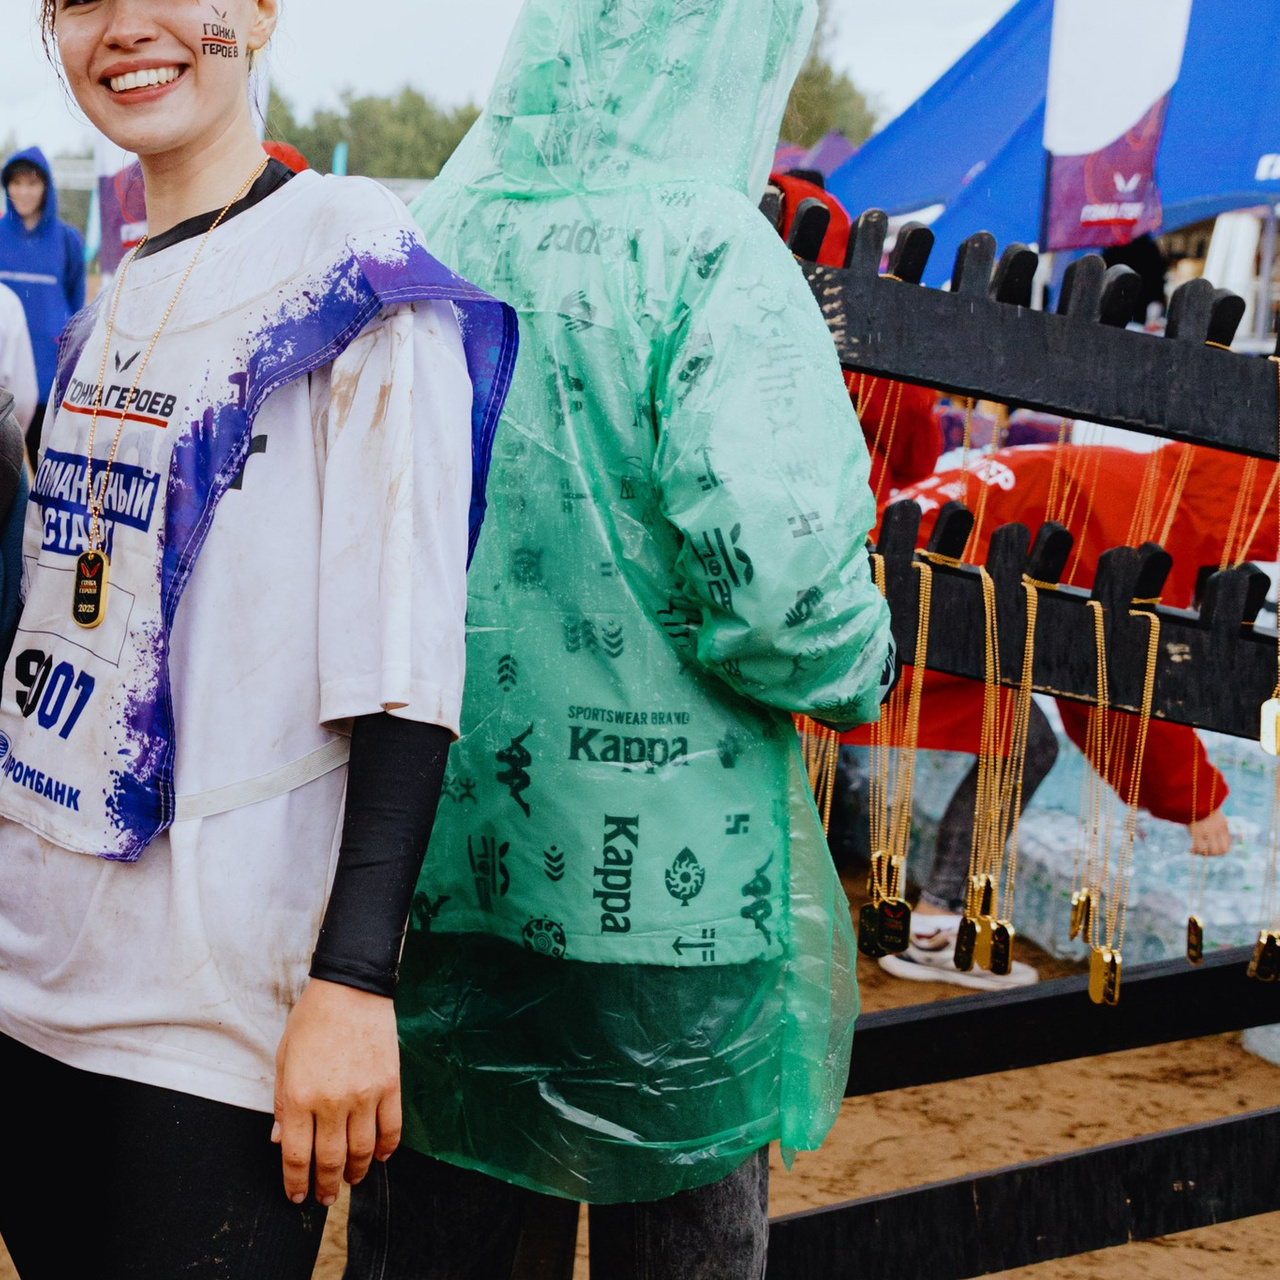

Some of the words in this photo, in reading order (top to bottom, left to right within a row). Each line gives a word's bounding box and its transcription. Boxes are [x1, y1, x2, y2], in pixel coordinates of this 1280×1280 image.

[201, 43, 239, 58] ГЕРОЕВ
[202, 23, 236, 40] ГОНКА
[65, 378, 105, 407] ГОНКА
[104, 385, 177, 417] ГЕРОЕВ
[33, 458, 155, 521] ОМАНДНЫЙ
[43, 507, 114, 556] СТАРТ
[77, 604, 95, 613] 2025
[568, 705, 648, 725] SPORTSWEAR
[651, 711, 690, 725] BRAND
[567, 725, 690, 774] Kappa
[593, 813, 639, 934] Kappa
